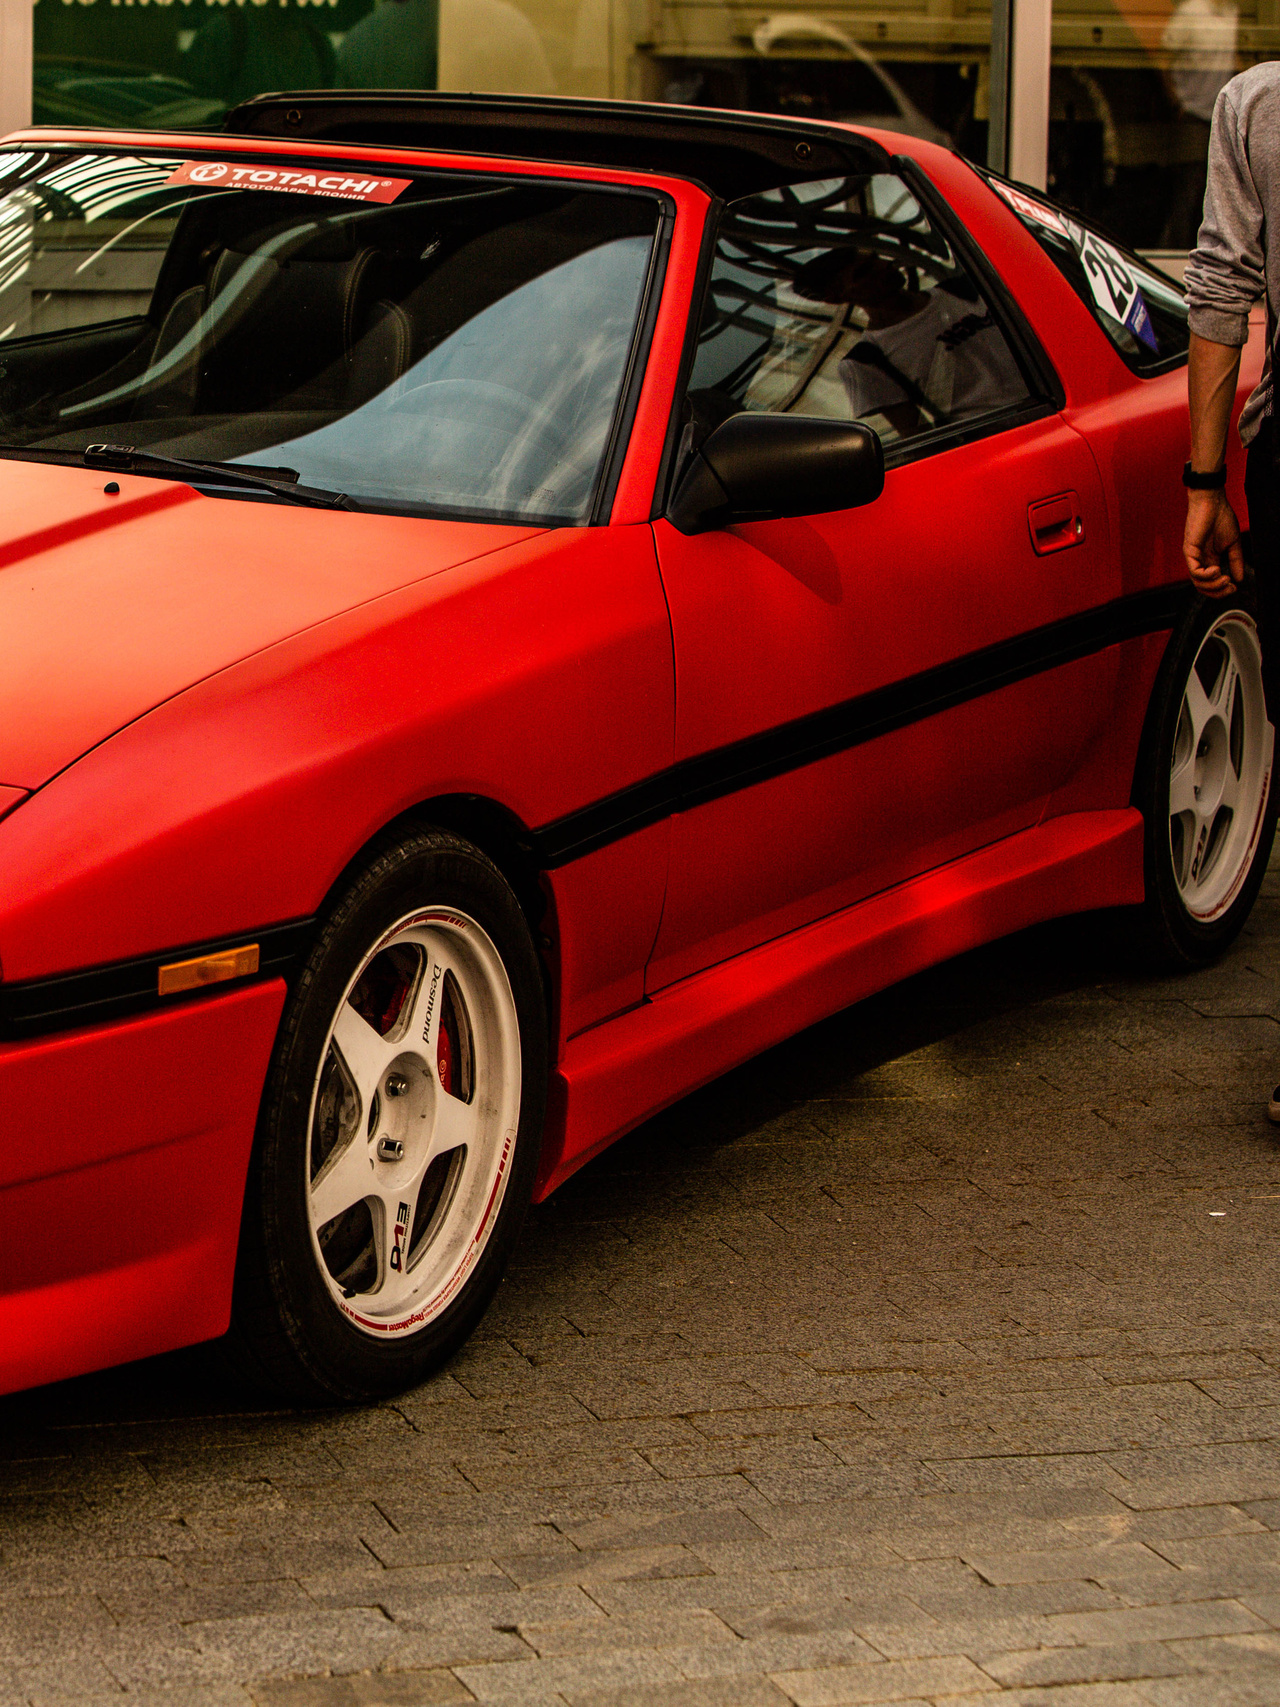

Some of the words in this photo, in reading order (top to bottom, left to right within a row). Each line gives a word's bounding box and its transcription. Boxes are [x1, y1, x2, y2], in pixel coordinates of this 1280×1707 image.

[224, 181, 307, 195] АВТОТОВАРЫ
[313, 189, 366, 201] ЯПОНИЯ
[231, 167, 382, 194] TOTACHI
[1083, 235, 1135, 320] 28
[422, 963, 442, 1044] Desmond
[390, 1201, 408, 1274] EVO
[388, 1312, 425, 1332] RegaMaster
